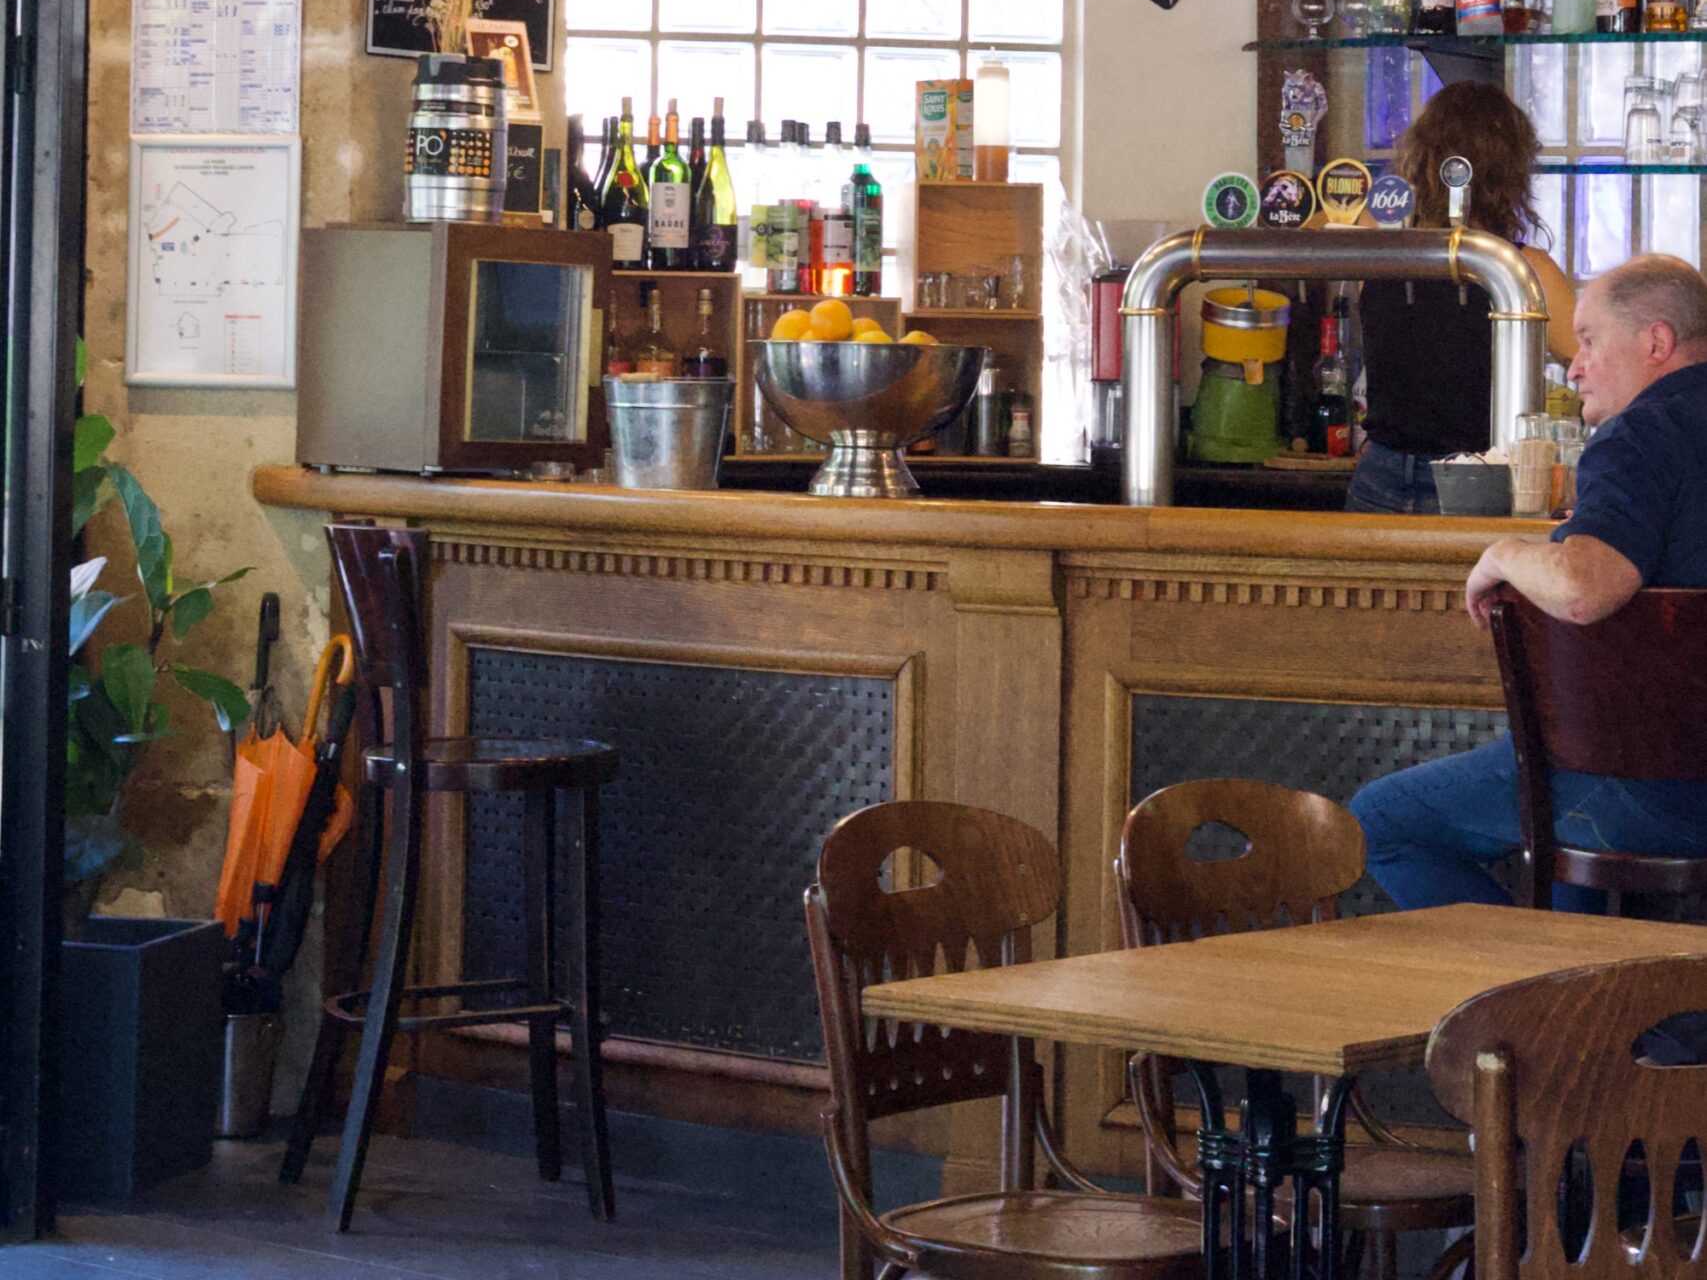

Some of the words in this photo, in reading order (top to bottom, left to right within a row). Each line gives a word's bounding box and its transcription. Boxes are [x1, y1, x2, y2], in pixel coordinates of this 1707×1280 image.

[923, 94, 945, 104] SAINT
[923, 103, 945, 114] LOUIS
[1327, 176, 1364, 195] BLONDE
[1370, 189, 1409, 209] 1664
[1269, 211, 1279, 221] la
[1279, 210, 1301, 223] Bête
